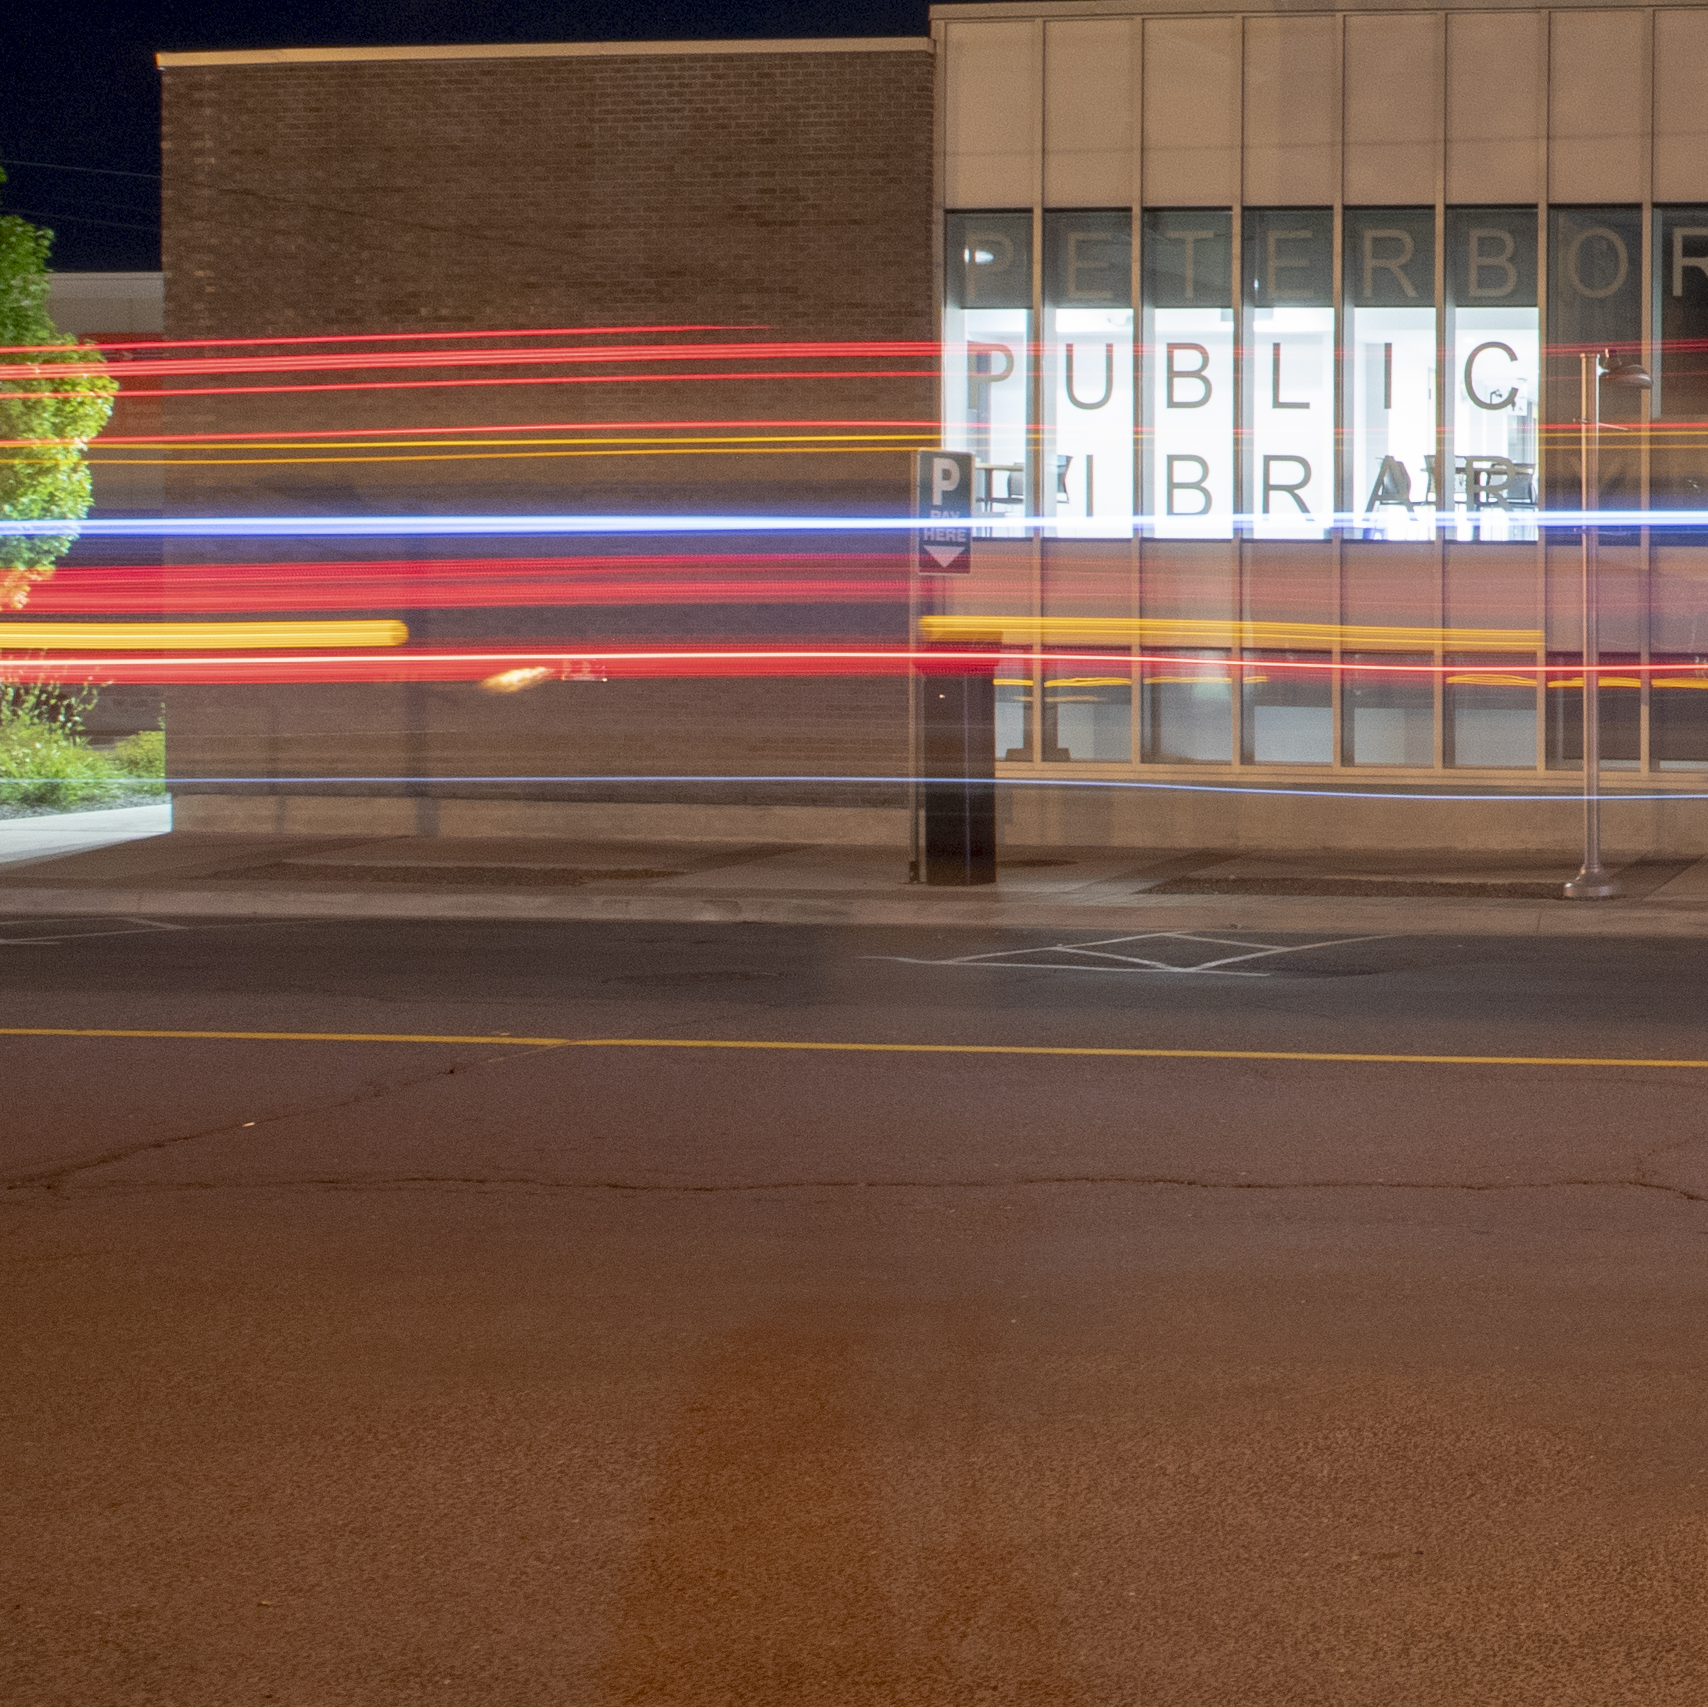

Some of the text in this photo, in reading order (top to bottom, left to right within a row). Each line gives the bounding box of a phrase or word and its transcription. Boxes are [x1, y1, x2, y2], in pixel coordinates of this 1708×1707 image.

[966, 340, 1519, 411] PUBLIC
[931, 457, 960, 506] P
[923, 527, 967, 542] HERE
